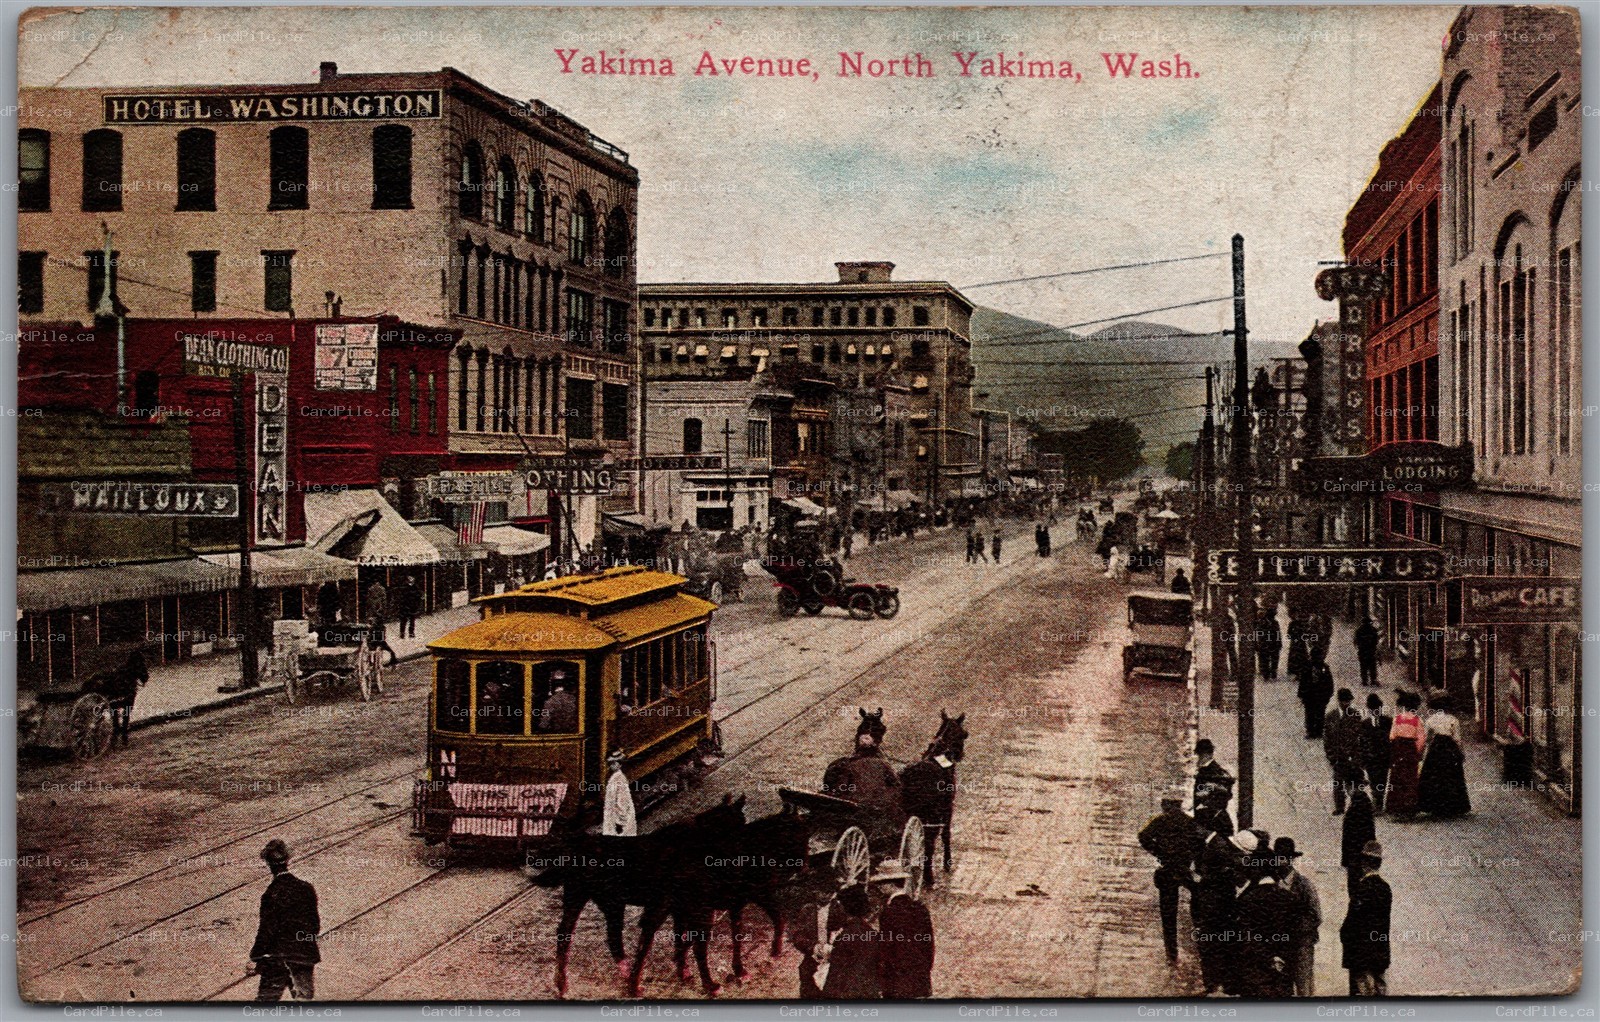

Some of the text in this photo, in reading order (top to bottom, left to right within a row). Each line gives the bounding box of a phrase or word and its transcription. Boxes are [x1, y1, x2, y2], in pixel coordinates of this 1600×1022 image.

[112, 97, 212, 120] HOTEL
[230, 94, 434, 118] WASHINGTON
[185, 336, 215, 363] DEAN
[216, 341, 270, 370] CLOTHING
[1346, 304, 1363, 438] DRUGS
[260, 384, 284, 534] DEAN
[1382, 465, 1460, 480] LODGING
[73, 489, 206, 512] MAILLOUX
[1519, 587, 1577, 607] CAFE
